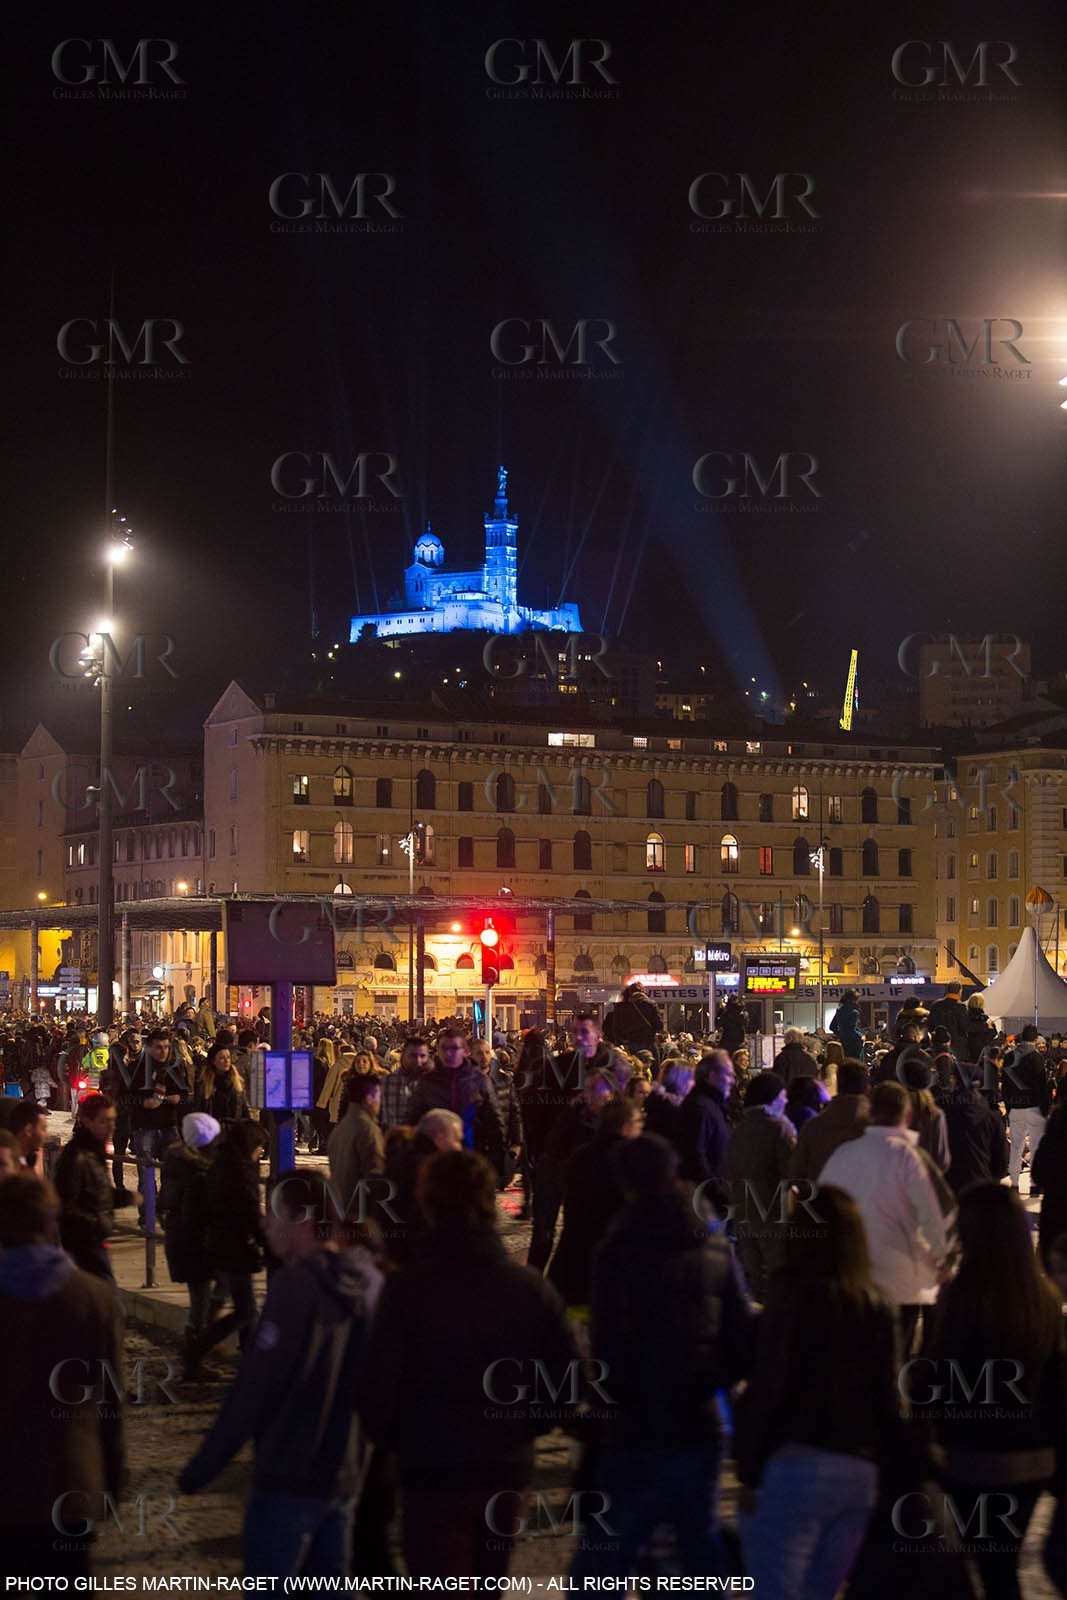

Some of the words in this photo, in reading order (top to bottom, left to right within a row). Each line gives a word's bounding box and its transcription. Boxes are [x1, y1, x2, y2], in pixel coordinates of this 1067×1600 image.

[707, 949, 730, 961] Métro
[647, 989, 698, 998] VETTES
[799, 988, 815, 997] ES
[890, 988, 902, 997] IF
